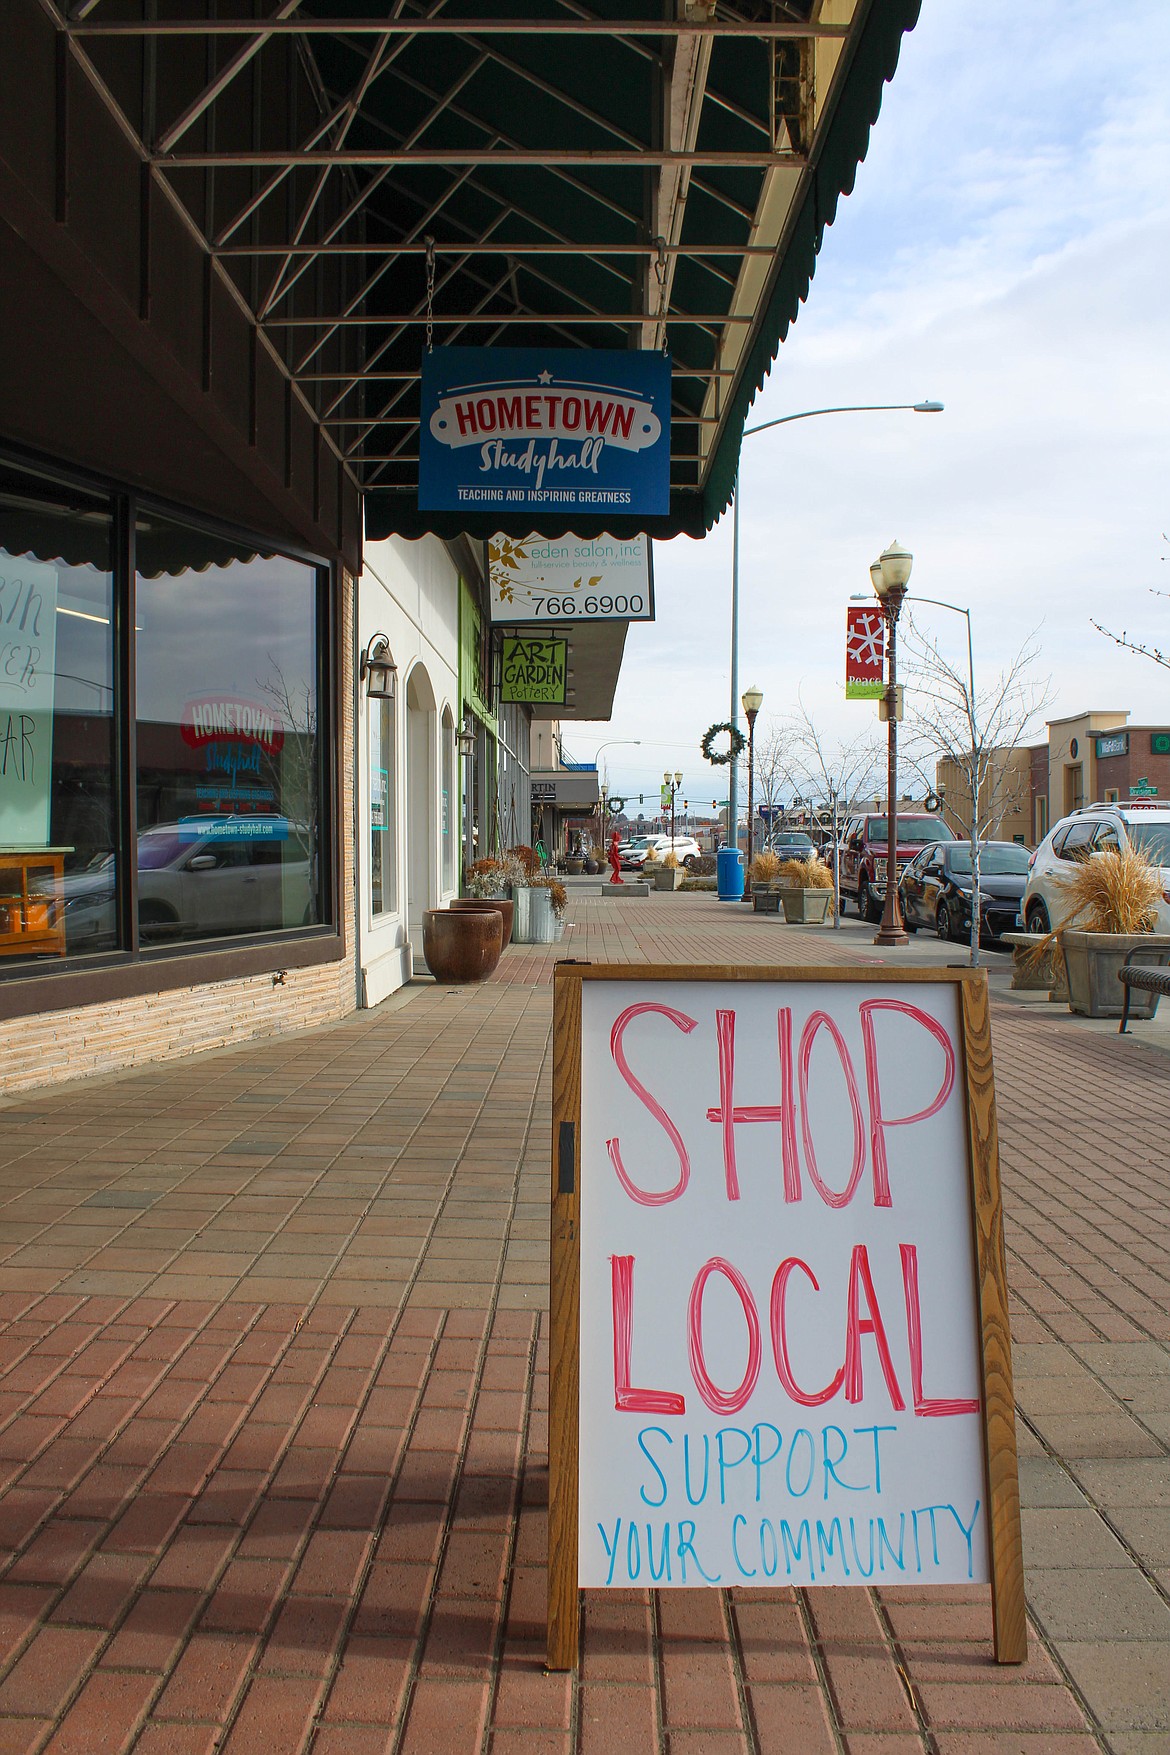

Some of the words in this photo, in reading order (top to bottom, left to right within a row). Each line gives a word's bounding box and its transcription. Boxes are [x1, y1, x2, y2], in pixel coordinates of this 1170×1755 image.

[454, 395, 635, 440] HOMETOWN
[478, 438, 604, 490] Studyhall
[457, 489, 503, 501] TEACHING
[506, 490, 525, 501] AND
[527, 490, 576, 502] INSPIRING
[578, 491, 631, 503] GREATNESS
[531, 542, 569, 559] eden
[531, 560, 570, 569] full-service
[573, 559, 598, 568] beauty
[601, 558, 608, 566] &
[610, 558, 641, 567] wellness
[531, 595, 643, 615] 766.6900
[505, 641, 563, 664] ART
[504, 664, 563, 685] GARDEN
[848, 675, 881, 687] Peace
[191, 702, 275, 746] HOMETOWN
[197, 823, 273, 837] www.hometown-studyhall.com
[605, 998, 955, 1208] SHOP
[607, 1243, 980, 1417] LOCAL
[637, 1423, 898, 1508] SUPPORT
[597, 1517, 721, 1585] YOUR
[731, 1500, 980, 1583] COMMUNITY
